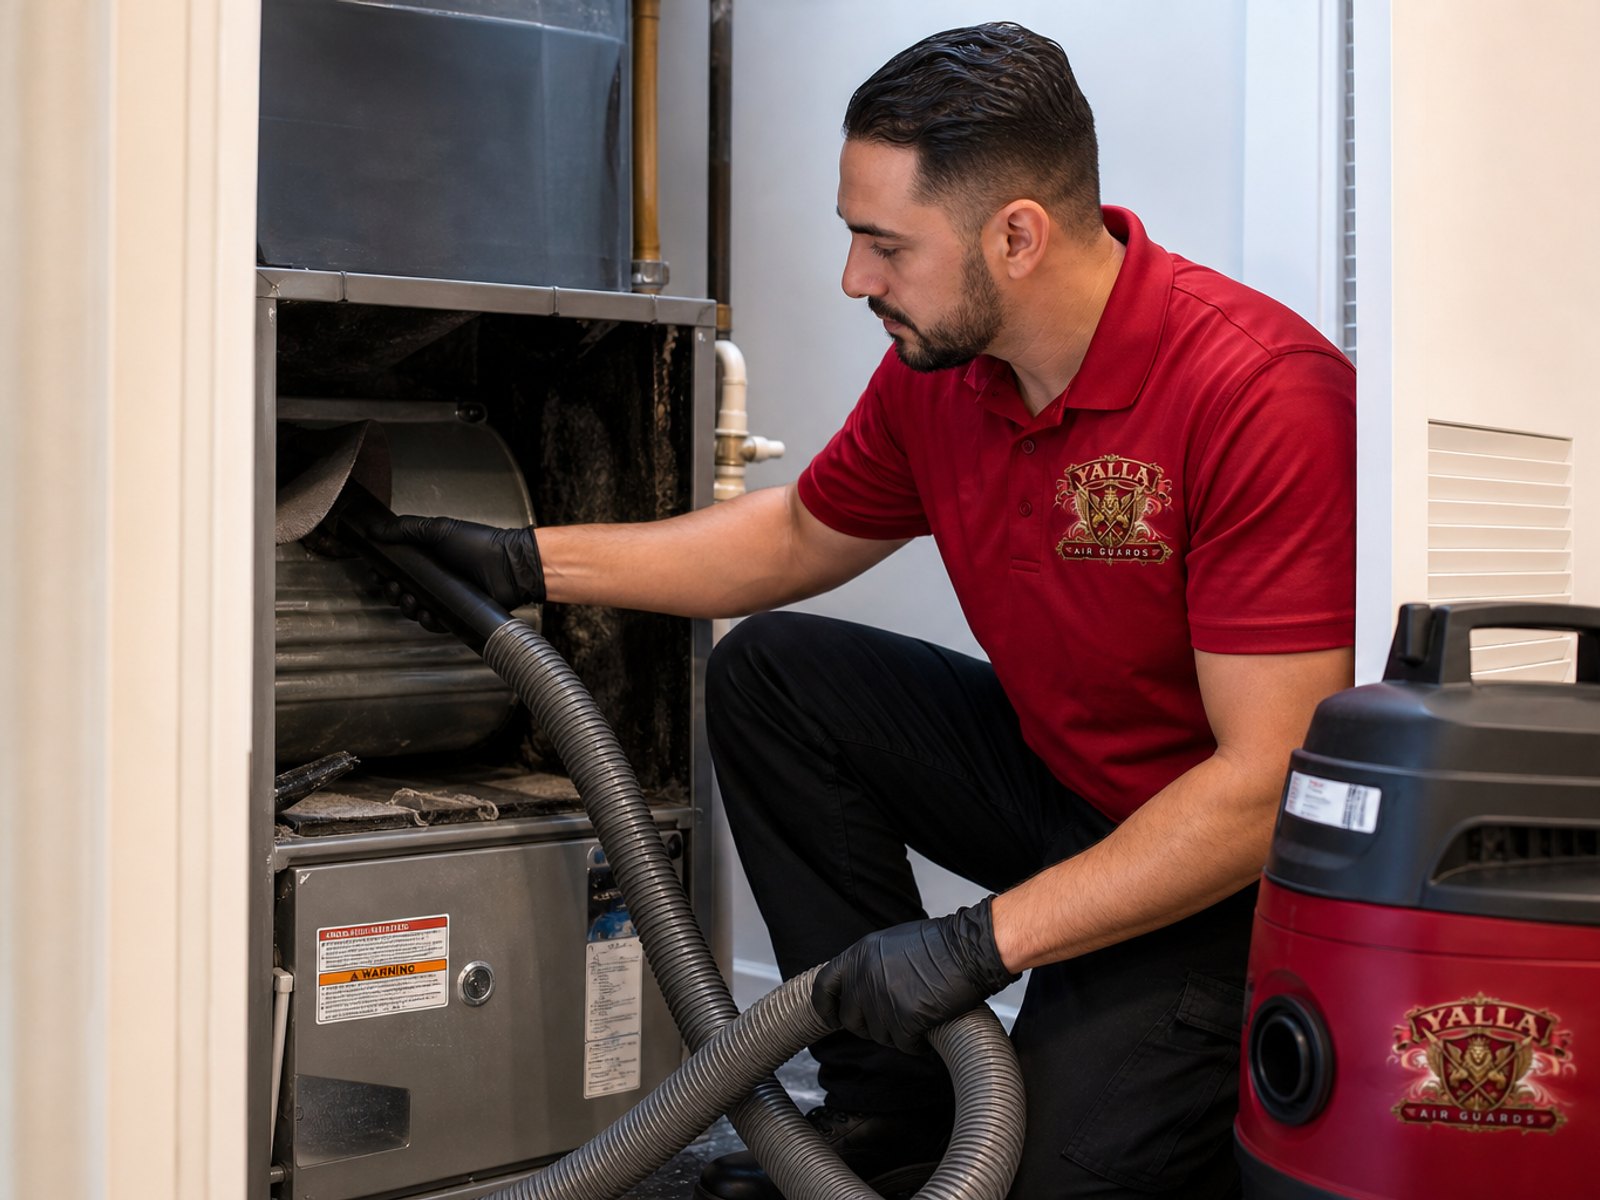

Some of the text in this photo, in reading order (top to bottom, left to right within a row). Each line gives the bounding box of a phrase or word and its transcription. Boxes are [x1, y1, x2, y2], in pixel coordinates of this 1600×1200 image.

[1074, 461, 1150, 487] YALLA
[1074, 546, 1093, 555] AIR
[1421, 1005, 1540, 1039] YALLA
[1420, 1108, 1535, 1125] AIR GUARDS
